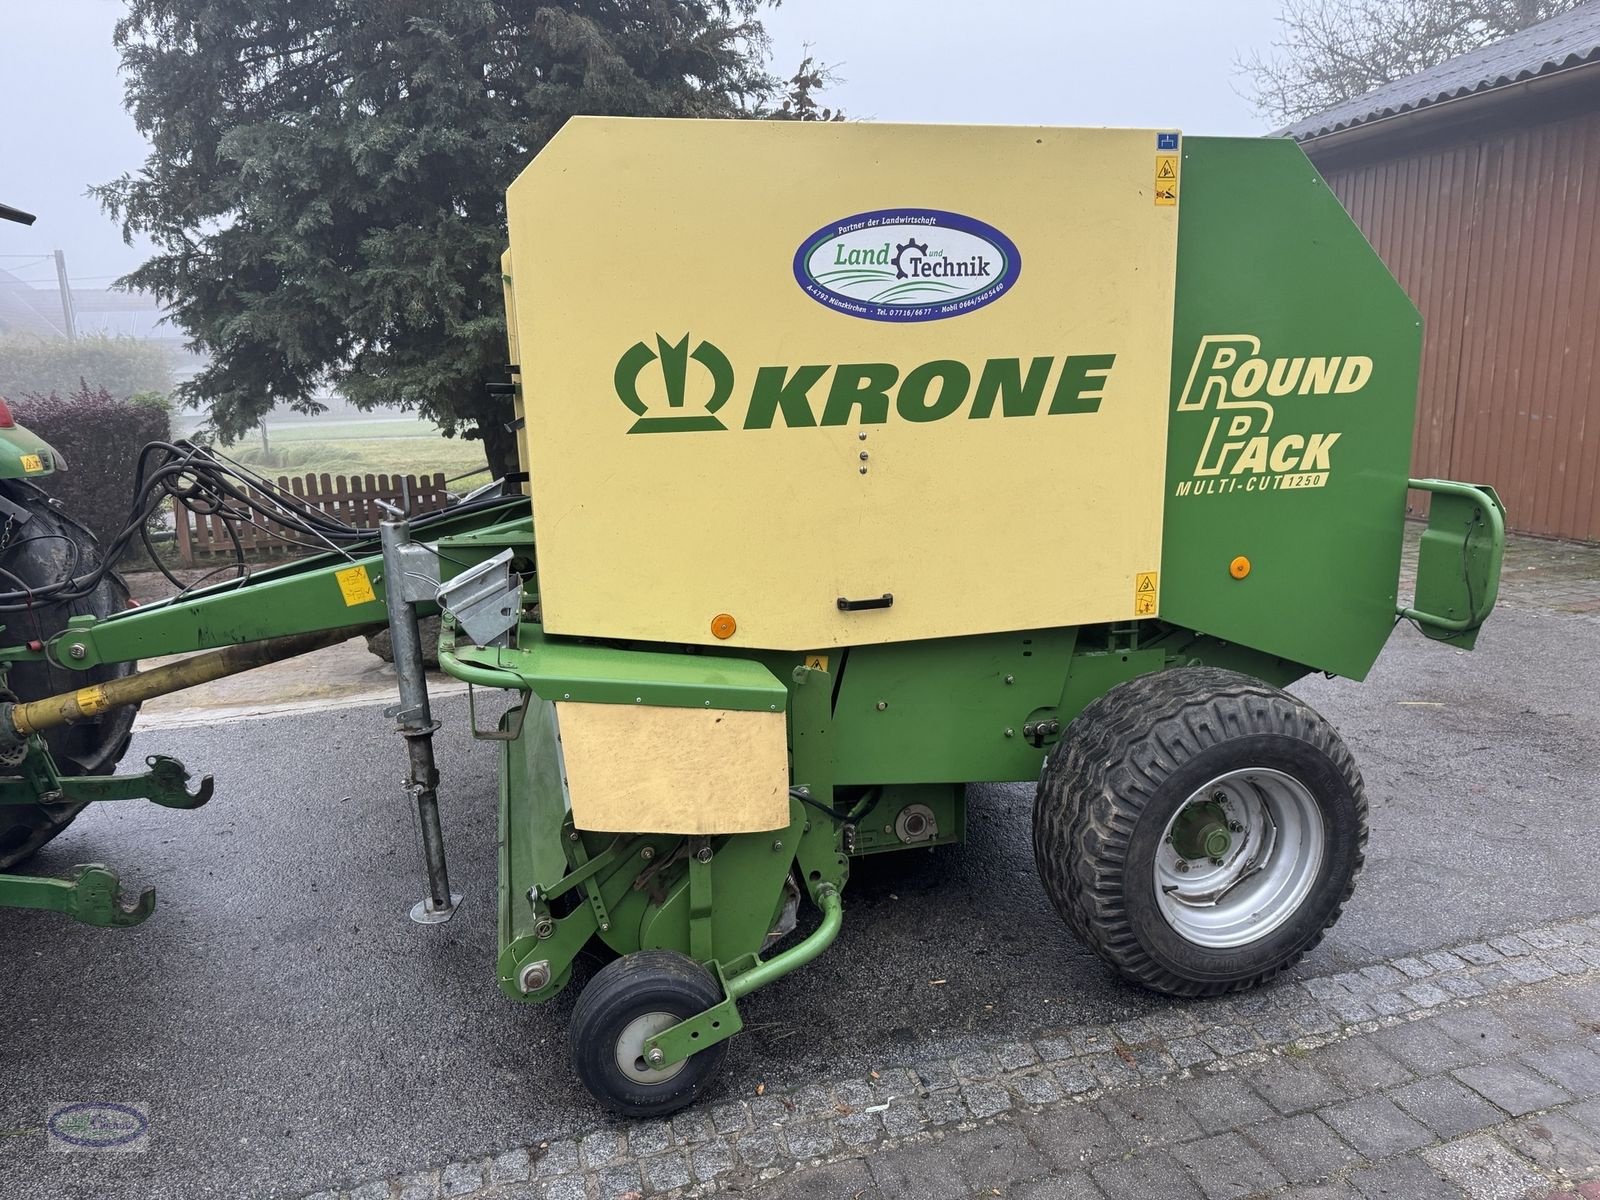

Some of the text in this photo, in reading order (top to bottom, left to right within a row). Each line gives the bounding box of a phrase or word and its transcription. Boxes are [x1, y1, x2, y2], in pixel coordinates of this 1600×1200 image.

[838, 216, 937, 235] Partner der Landwirtschaft
[833, 242, 944, 265] Land und
[909, 256, 991, 278] Technik
[828, 297, 867, 313] Münzkirchen
[941, 303, 958, 313] Mobil
[1176, 334, 1373, 411] ROUND
[743, 353, 1117, 431] KRONE
[1193, 400, 1342, 477] PACK
[1175, 474, 1322, 497] MULTI-CUT 1250
